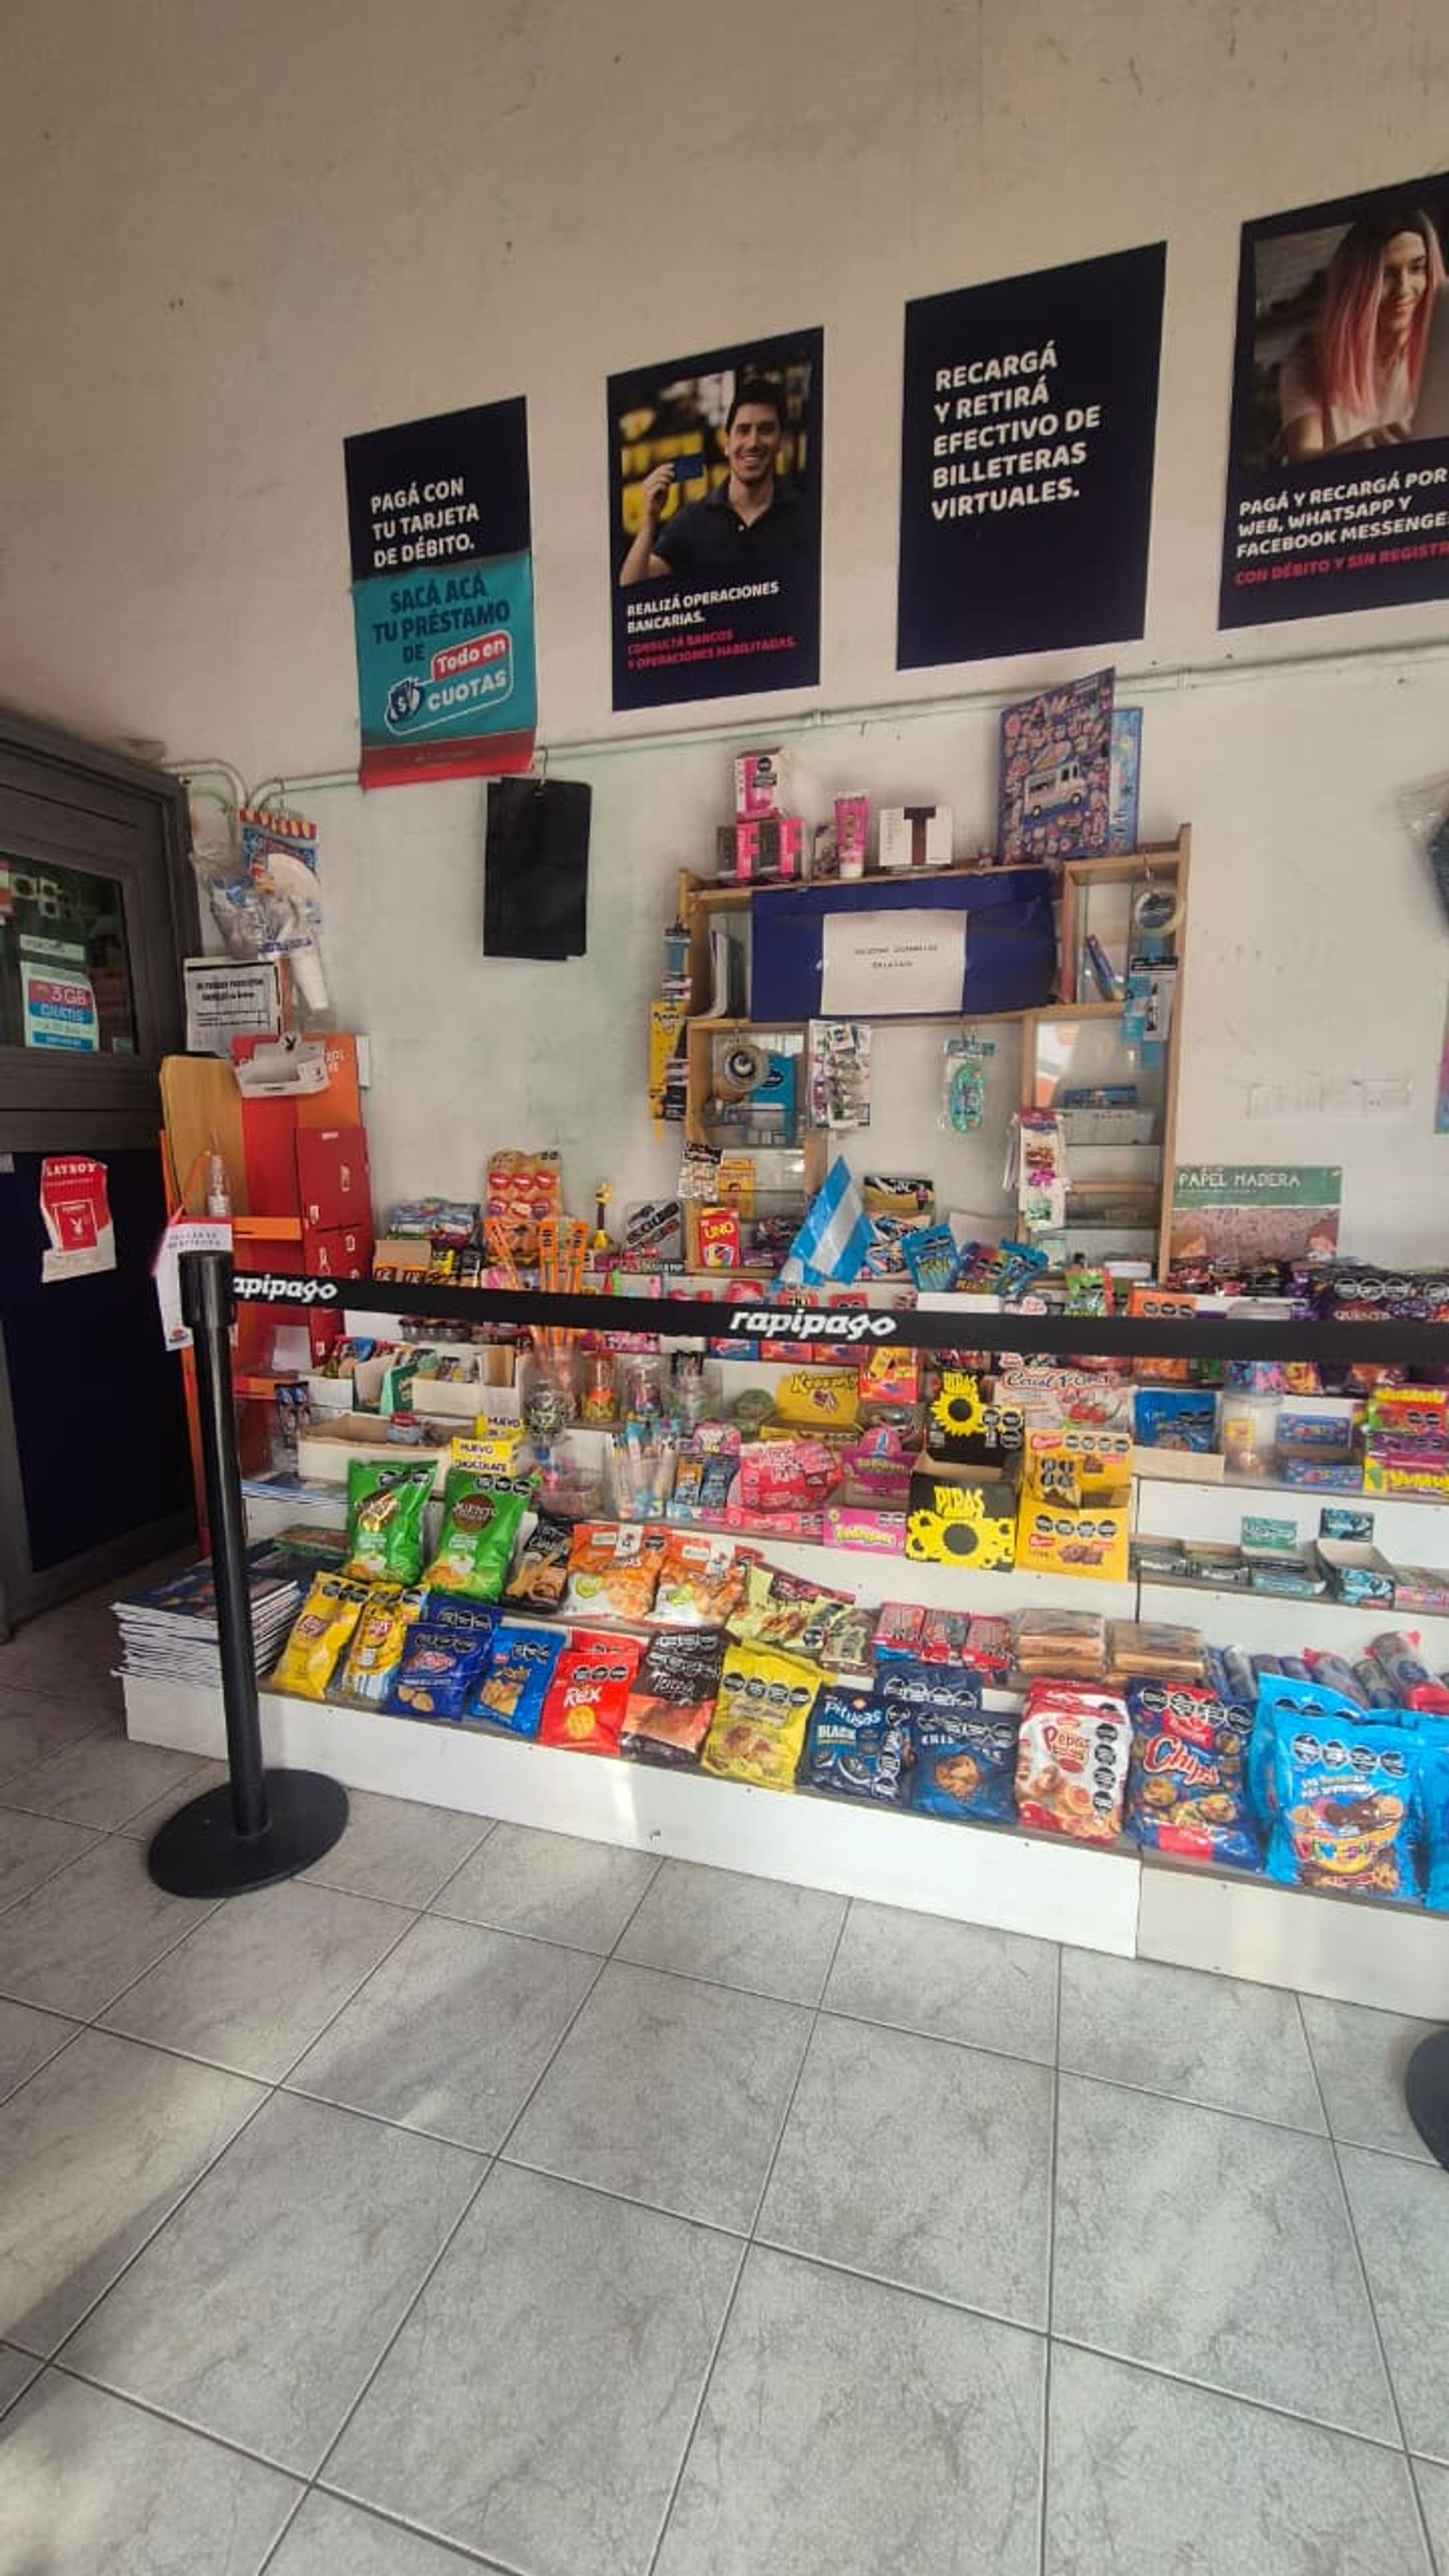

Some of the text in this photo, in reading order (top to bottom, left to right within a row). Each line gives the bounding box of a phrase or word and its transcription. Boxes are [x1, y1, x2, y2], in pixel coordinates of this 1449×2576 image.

[935, 340, 1058, 392] RECARGÁ
[934, 375, 1050, 424] Y RETIRÁ
[934, 405, 1102, 457] EFECTIVO DE
[933, 442, 1088, 489] BILLETERAS
[371, 476, 464, 515] PAGÁ CON
[931, 476, 1081, 521] VIRTUALES.
[1239, 466, 1449, 516] PAGÁ Y RECARGÁ POR
[372, 502, 480, 540] TU TARJETA
[1236, 510, 1449, 559] FACEBOOK MESSENGE
[1238, 495, 1413, 537] WEB, WHATSAPP Y
[374, 533, 475, 568] DE DÉBITO.
[1235, 570, 1267, 586] CON
[1272, 558, 1331, 580] DÉBITO
[1334, 557, 1345, 570] Y
[1347, 552, 1376, 570] SIN
[389, 572, 487, 614] SACÁ ACÁ
[627, 581, 780, 617] REALIZÁ OPERACIONES
[372, 601, 510, 644] TU PRÉSTAMO
[627, 611, 706, 634] BANCARIAS.
[686, 629, 734, 648] BANCOS
[402, 639, 506, 674] DE Todo en
[636, 647, 714, 669] OPERACIONES
[427, 669, 507, 711] CUOTAS
[1179, 1172, 1301, 1188] PAPEL MADERA
[704, 1220, 735, 1239] UNO
[232, 1273, 338, 1303] apipago
[729, 1308, 897, 1341] rapipago
[934, 1485, 985, 1518] PIPAS
[817, 1724, 857, 1738] BLACK
